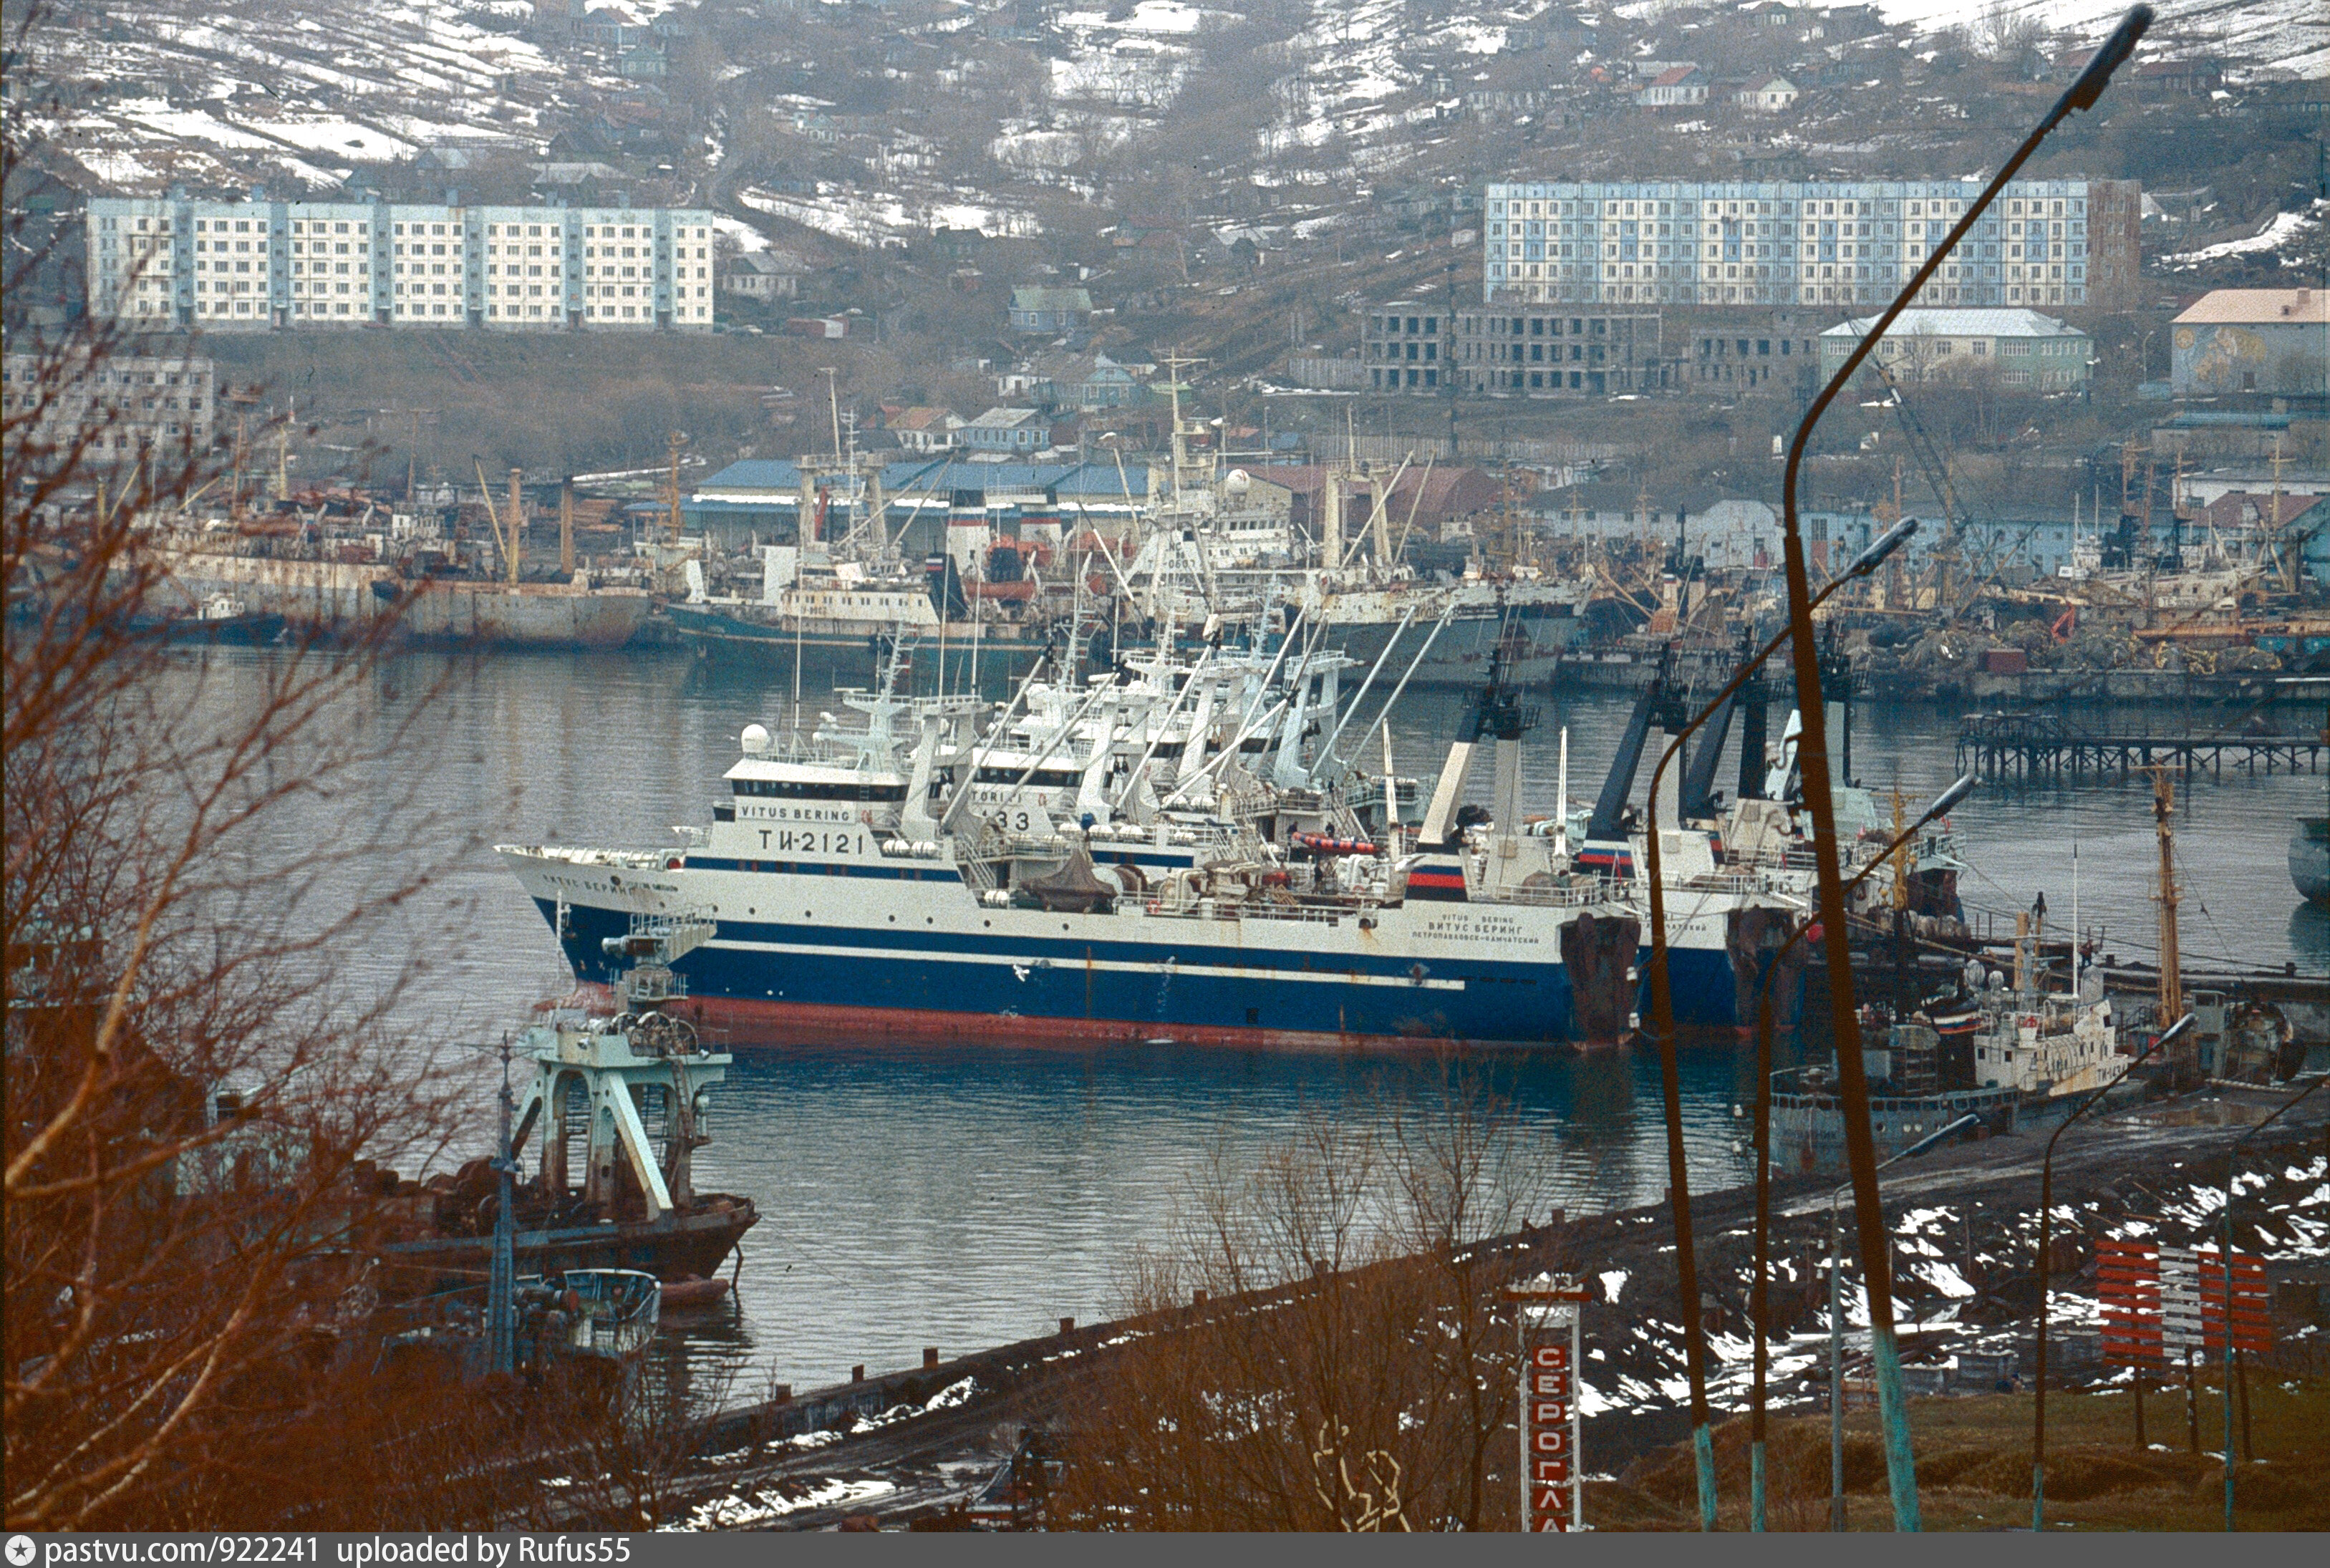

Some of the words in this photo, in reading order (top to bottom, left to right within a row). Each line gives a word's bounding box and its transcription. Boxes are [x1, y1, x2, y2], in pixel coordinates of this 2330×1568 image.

[741, 805, 788, 818] VITUS
[793, 808, 850, 822] BERING
[758, 829, 864, 855] ТИ-2121
[1428, 921, 1469, 932] ВИТУС
[1474, 924, 1524, 935] БЕРИНГ
